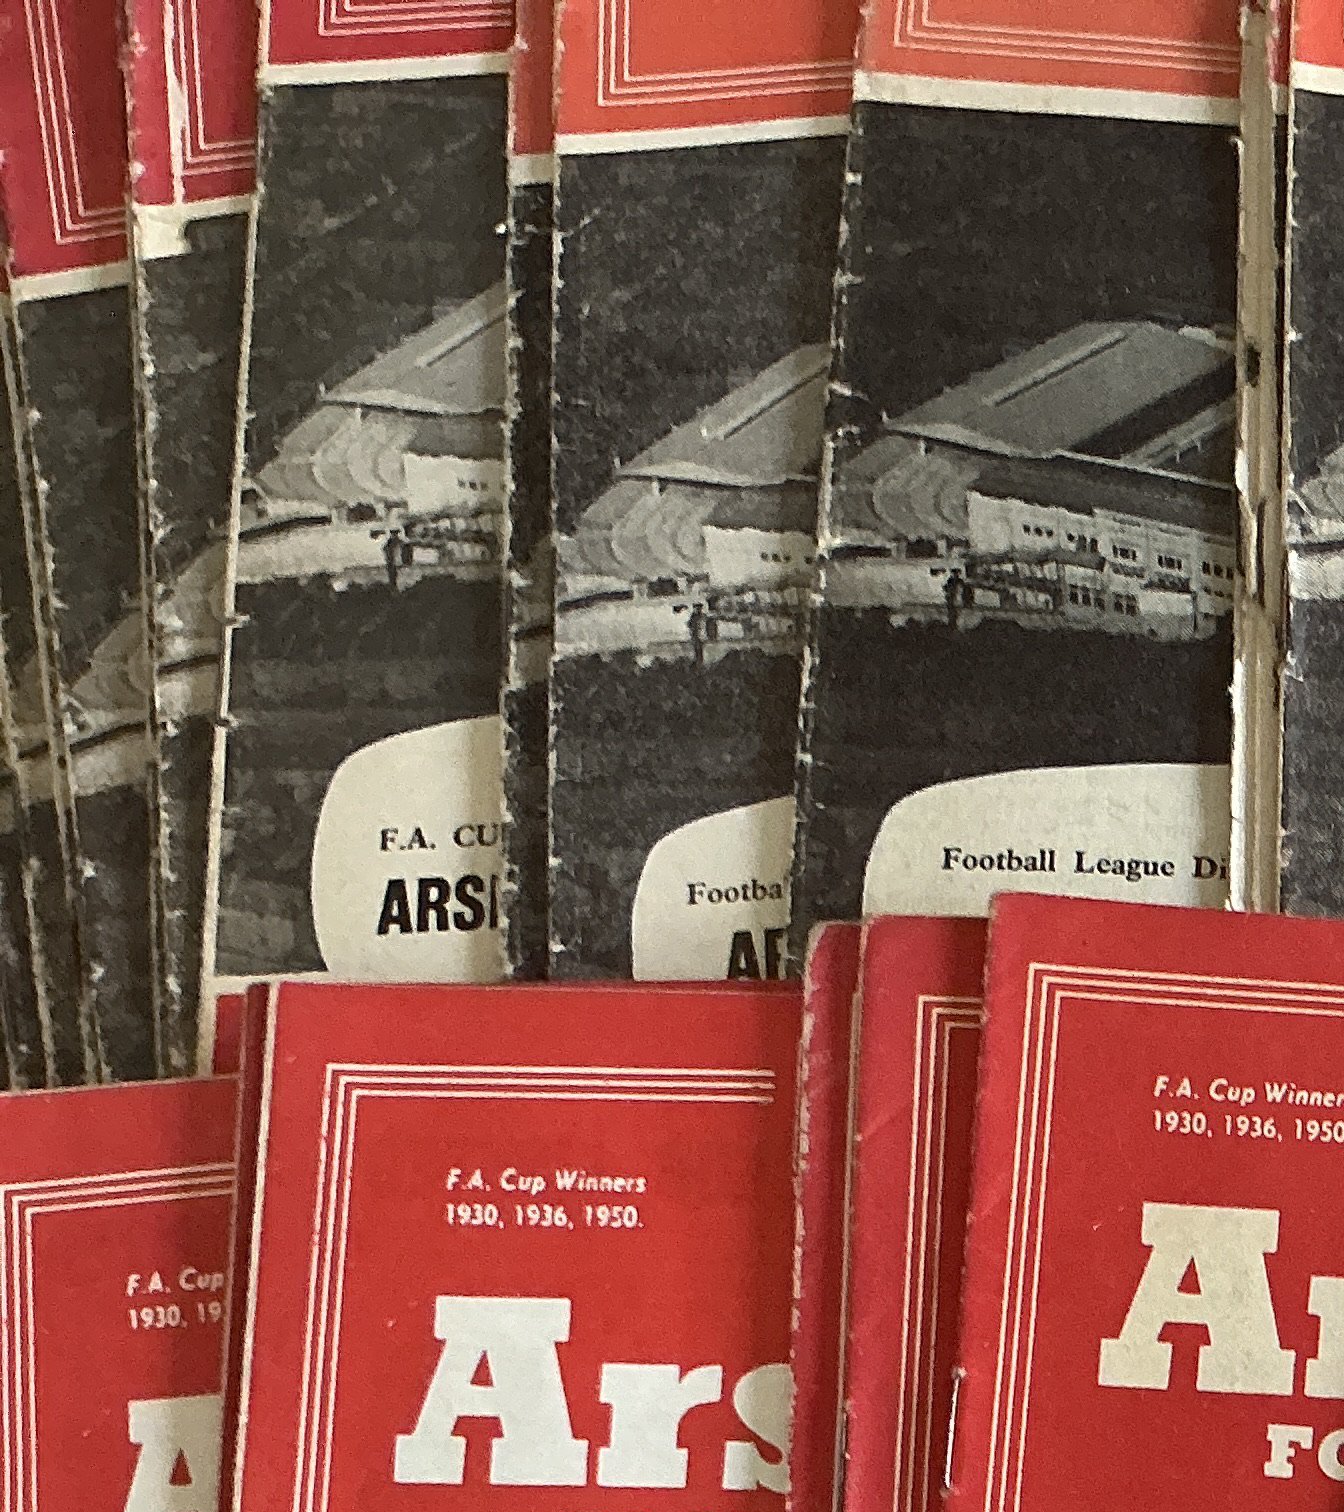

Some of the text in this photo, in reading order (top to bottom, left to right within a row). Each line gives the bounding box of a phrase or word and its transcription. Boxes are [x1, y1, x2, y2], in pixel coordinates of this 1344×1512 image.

[379, 827, 436, 852] F.A.
[941, 846, 1056, 873] Football
[1073, 850, 1175, 883] League
[1152, 1075, 1200, 1100] F.A.
[1208, 1077, 1256, 1107] Cup
[1153, 1109, 1213, 1138] 1930,
[1224, 1113, 1283, 1142] 1936,
[445, 1168, 648, 1197] F.A. Cup Winners
[445, 1201, 645, 1231] 1930, 1936, 1950.
[179, 1265, 224, 1293] Cup
[129, 1304, 188, 1331] 1930,
